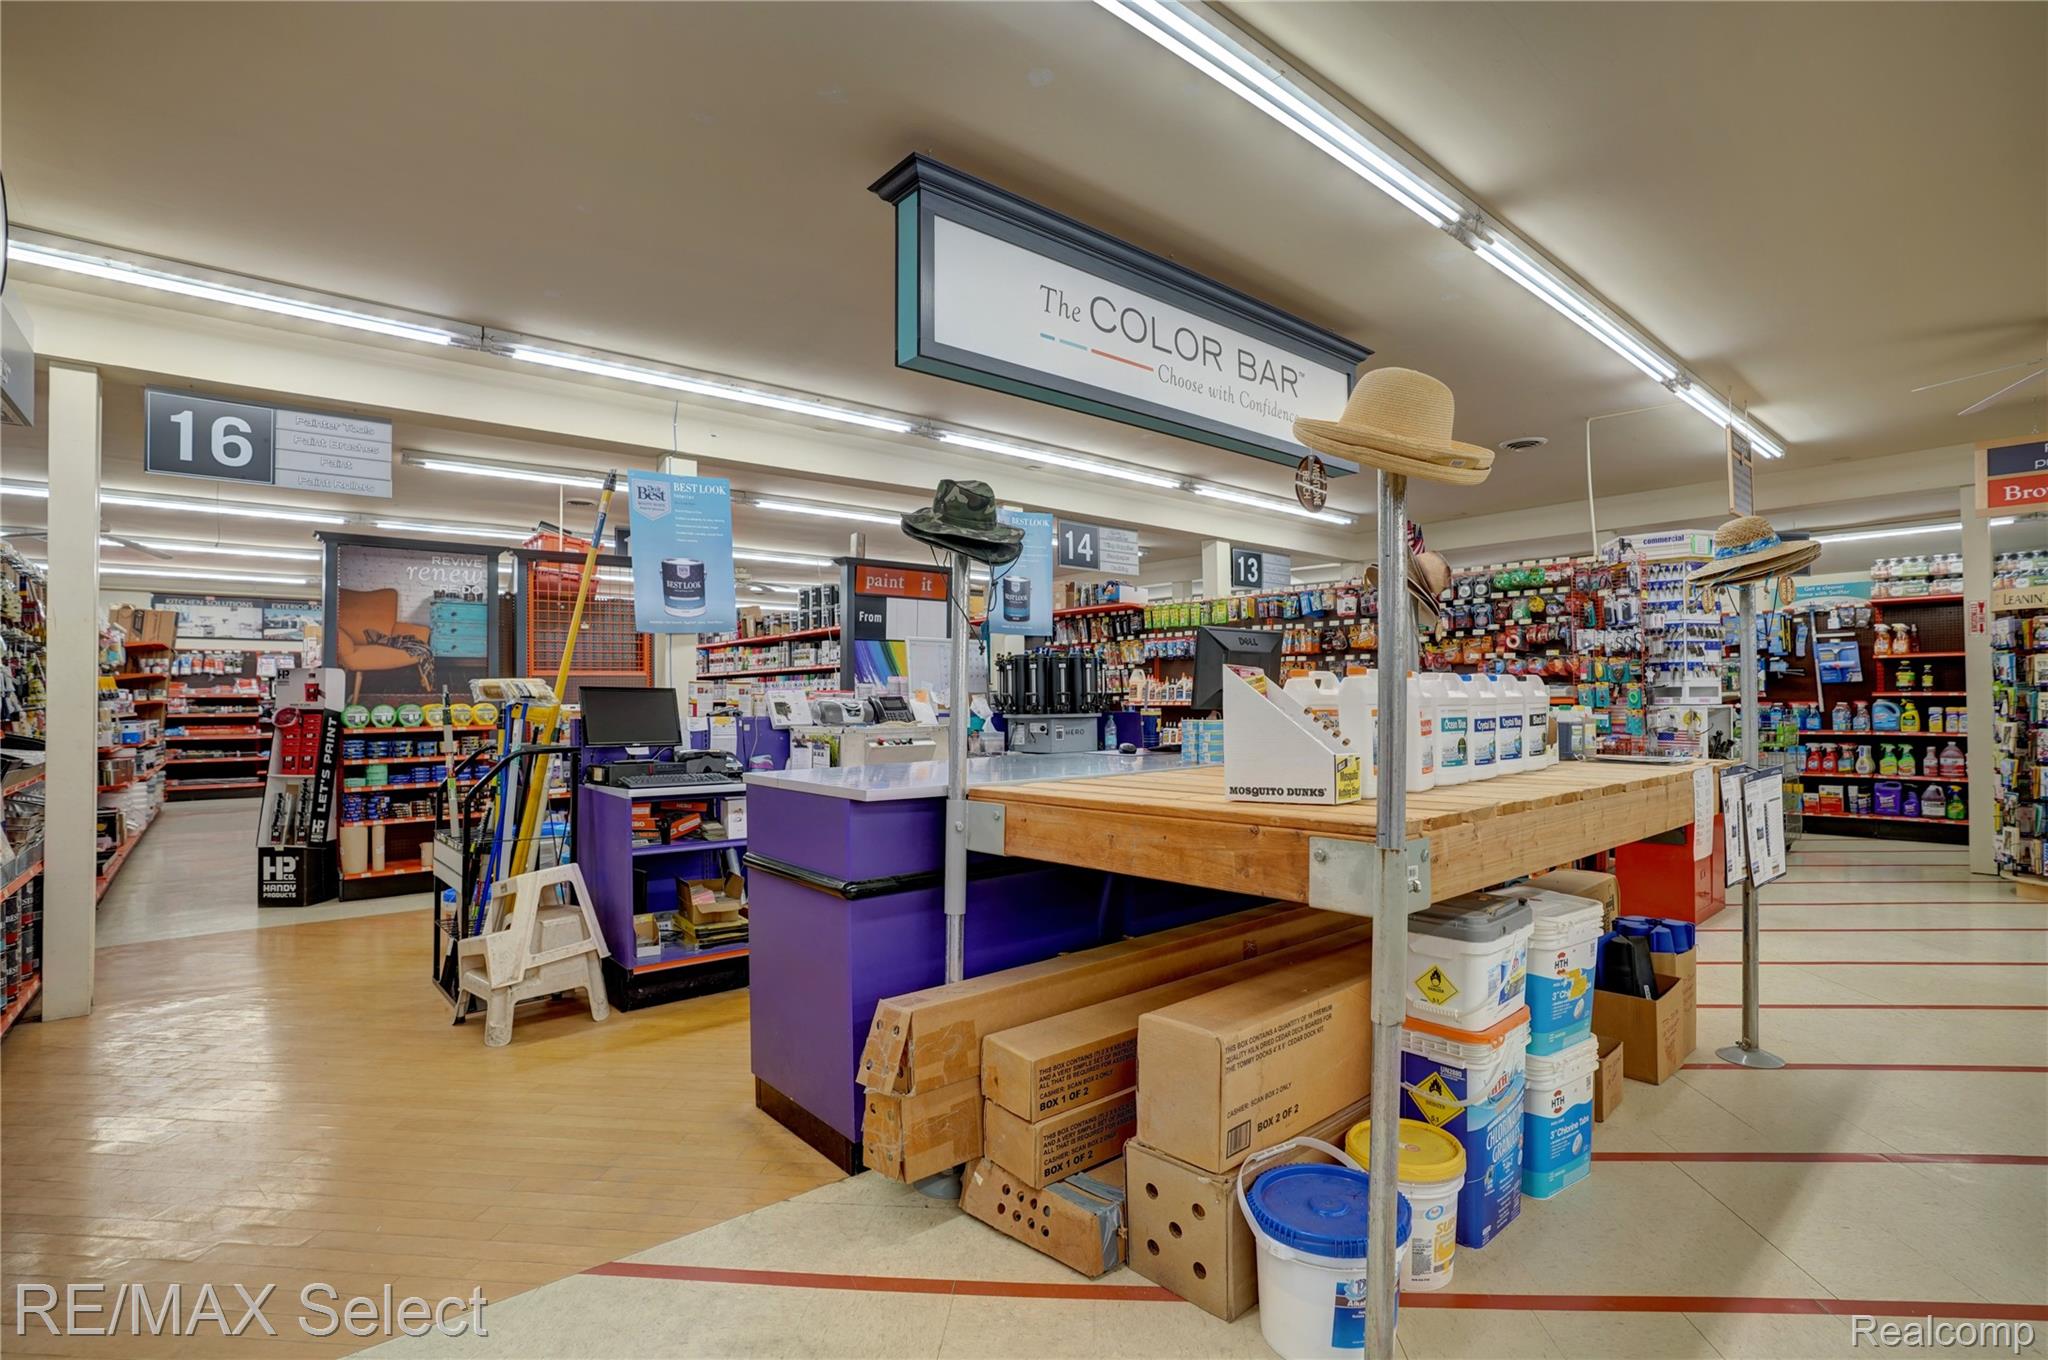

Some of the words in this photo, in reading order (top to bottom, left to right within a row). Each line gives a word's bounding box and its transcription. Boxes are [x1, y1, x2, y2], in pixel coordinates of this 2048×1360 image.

[1040, 284, 1081, 322] The
[1090, 295, 1223, 372] COLOR
[1158, 363, 1204, 395] Choose
[1208, 384, 1235, 404] with
[1239, 392, 1298, 425] Confidenc
[170, 410, 253, 467] 16
[293, 435, 327, 449] Paint
[320, 456, 352, 470] Paint
[298, 475, 331, 488] Paint
[638, 486, 666, 502] Best
[673, 482, 698, 493] BEST
[700, 484, 727, 496] LOOK
[2003, 485, 2048, 501] Bro
[1064, 530, 1094, 562] 14
[1643, 534, 1684, 544] commercial
[432, 556, 482, 568] REVIVE
[406, 564, 483, 584] renew
[1238, 556, 1258, 584] 13
[666, 580, 682, 589] BEST
[684, 582, 702, 590] LOOK
[866, 573, 905, 590] paint
[921, 577, 933, 592] it
[206, 600, 253, 608] SOLUTIONS
[858, 611, 882, 623] From
[1238, 636, 1258, 646] DELL
[1066, 728, 1085, 736] HERO
[316, 768, 331, 813] LET'S
[1229, 786, 1284, 798] MOSQUITO
[1286, 787, 1326, 798] DUNKS
[263, 856, 296, 880] HP
[263, 884, 296, 892] HANDY
[1554, 958, 1569, 970] HTH
[1323, 1013, 1332, 1022] FOR
[1237, 1038, 1248, 1049] BOX
[1040, 1066, 1052, 1076] THIS
[1053, 1062, 1065, 1070] BOX
[1066, 1052, 1092, 1067] CONTAINS
[1040, 1074, 1052, 1084] AND
[1057, 1067, 1072, 1076] VERY
[1072, 1060, 1092, 1071] SIMPLE
[1040, 1082, 1050, 1090] ALL
[1051, 1076, 1065, 1085] THAT
[1066, 1079, 1082, 1090] SCAN
[1083, 1076, 1096, 1086] BOX
[1040, 1097, 1058, 1112] BOX
[1062, 1095, 1066, 1103] 1
[1069, 1090, 1081, 1100] OF
[1083, 1087, 1089, 1096] 2
[1250, 1096, 1265, 1108] SCAN
[1265, 1090, 1276, 1101] BOX
[1280, 1082, 1292, 1094] ONLY
[1551, 1096, 1565, 1108] HTH
[1257, 1116, 1274, 1133] BOX
[1276, 1113, 1281, 1122] 2
[1282, 1108, 1294, 1120] OF
[1294, 1104, 1300, 1114] 2
[1044, 1132, 1056, 1140] THIS
[1558, 1122, 1578, 1136] Chlorine
[1044, 1140, 1056, 1148] AND
[1062, 1132, 1076, 1141] VERY
[1056, 1140, 1070, 1150] THAT
[1071, 1144, 1086, 1154] SCAN
[1044, 1163, 1064, 1178] BOX
[1066, 1160, 1070, 1168] 1
[1074, 1152, 1086, 1164] OF
[1088, 1150, 1094, 1160] 2
